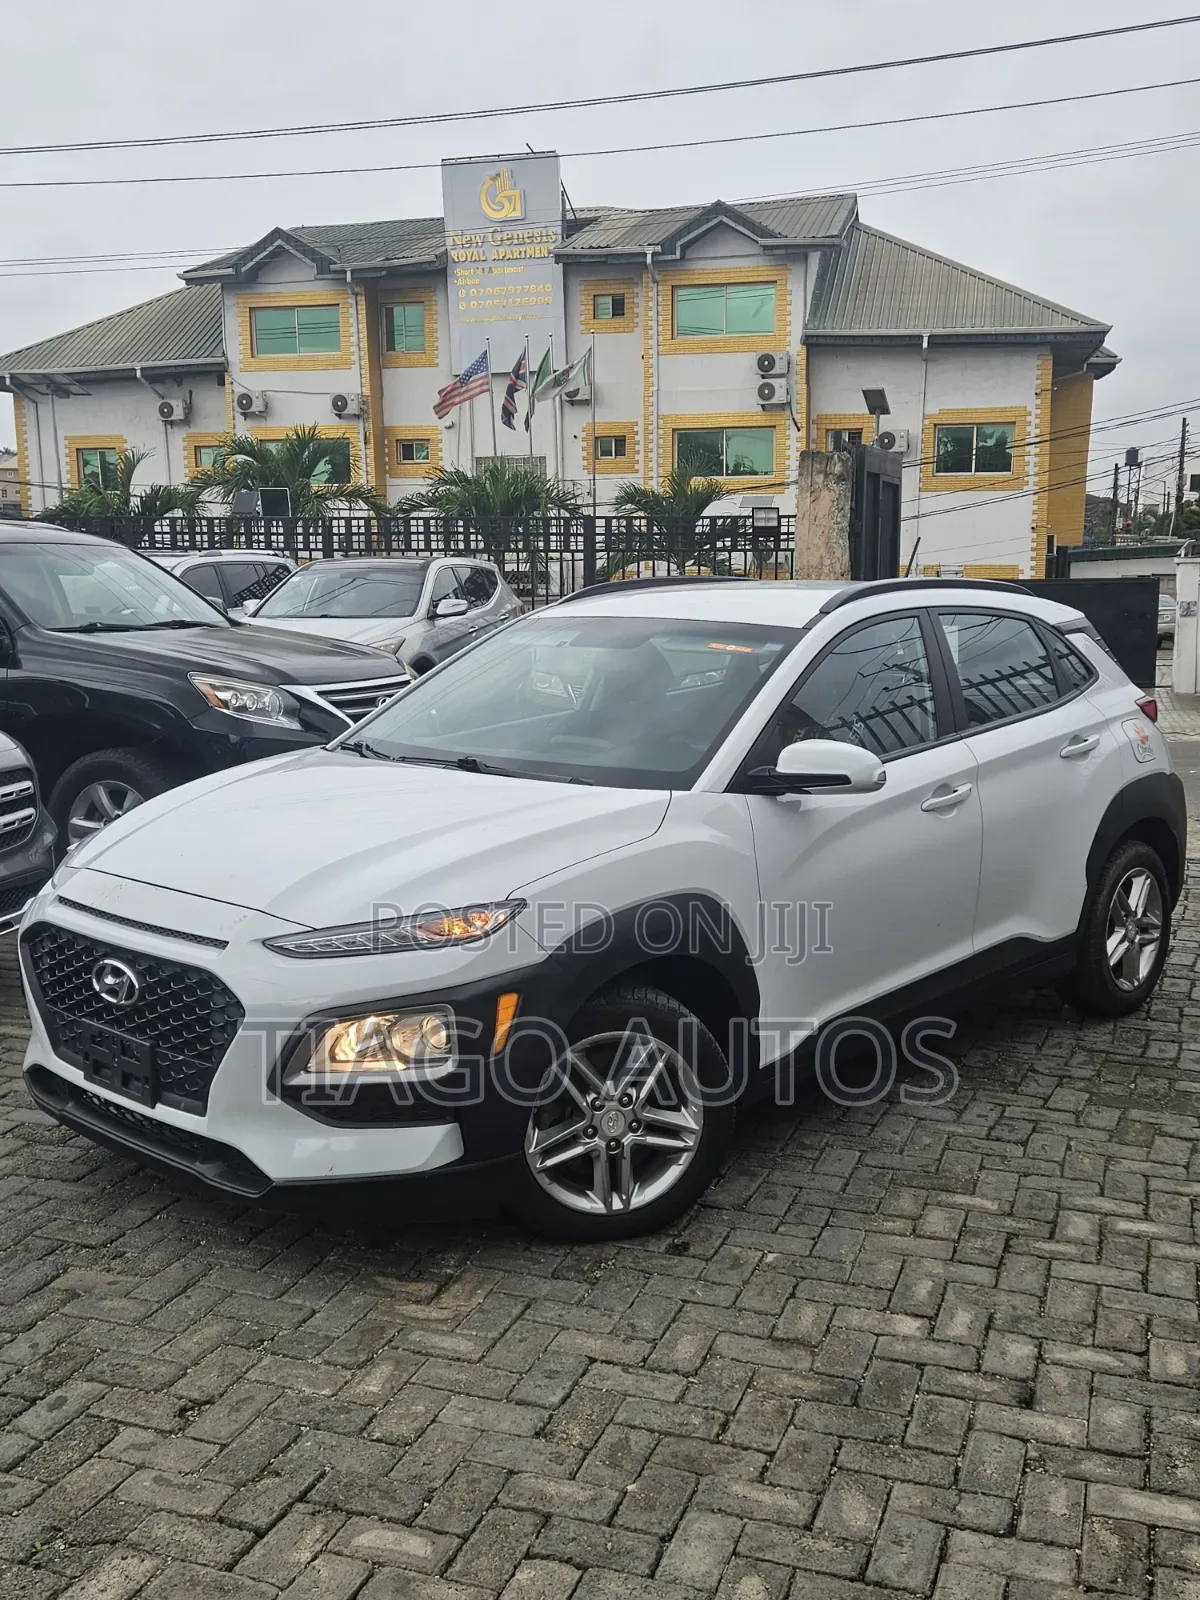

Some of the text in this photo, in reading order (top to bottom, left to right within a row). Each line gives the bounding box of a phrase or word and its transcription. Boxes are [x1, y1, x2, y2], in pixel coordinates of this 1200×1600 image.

[450, 227, 557, 249] New Genesis
[451, 249, 487, 262] ROYAL
[457, 278, 480, 286] Airbnb
